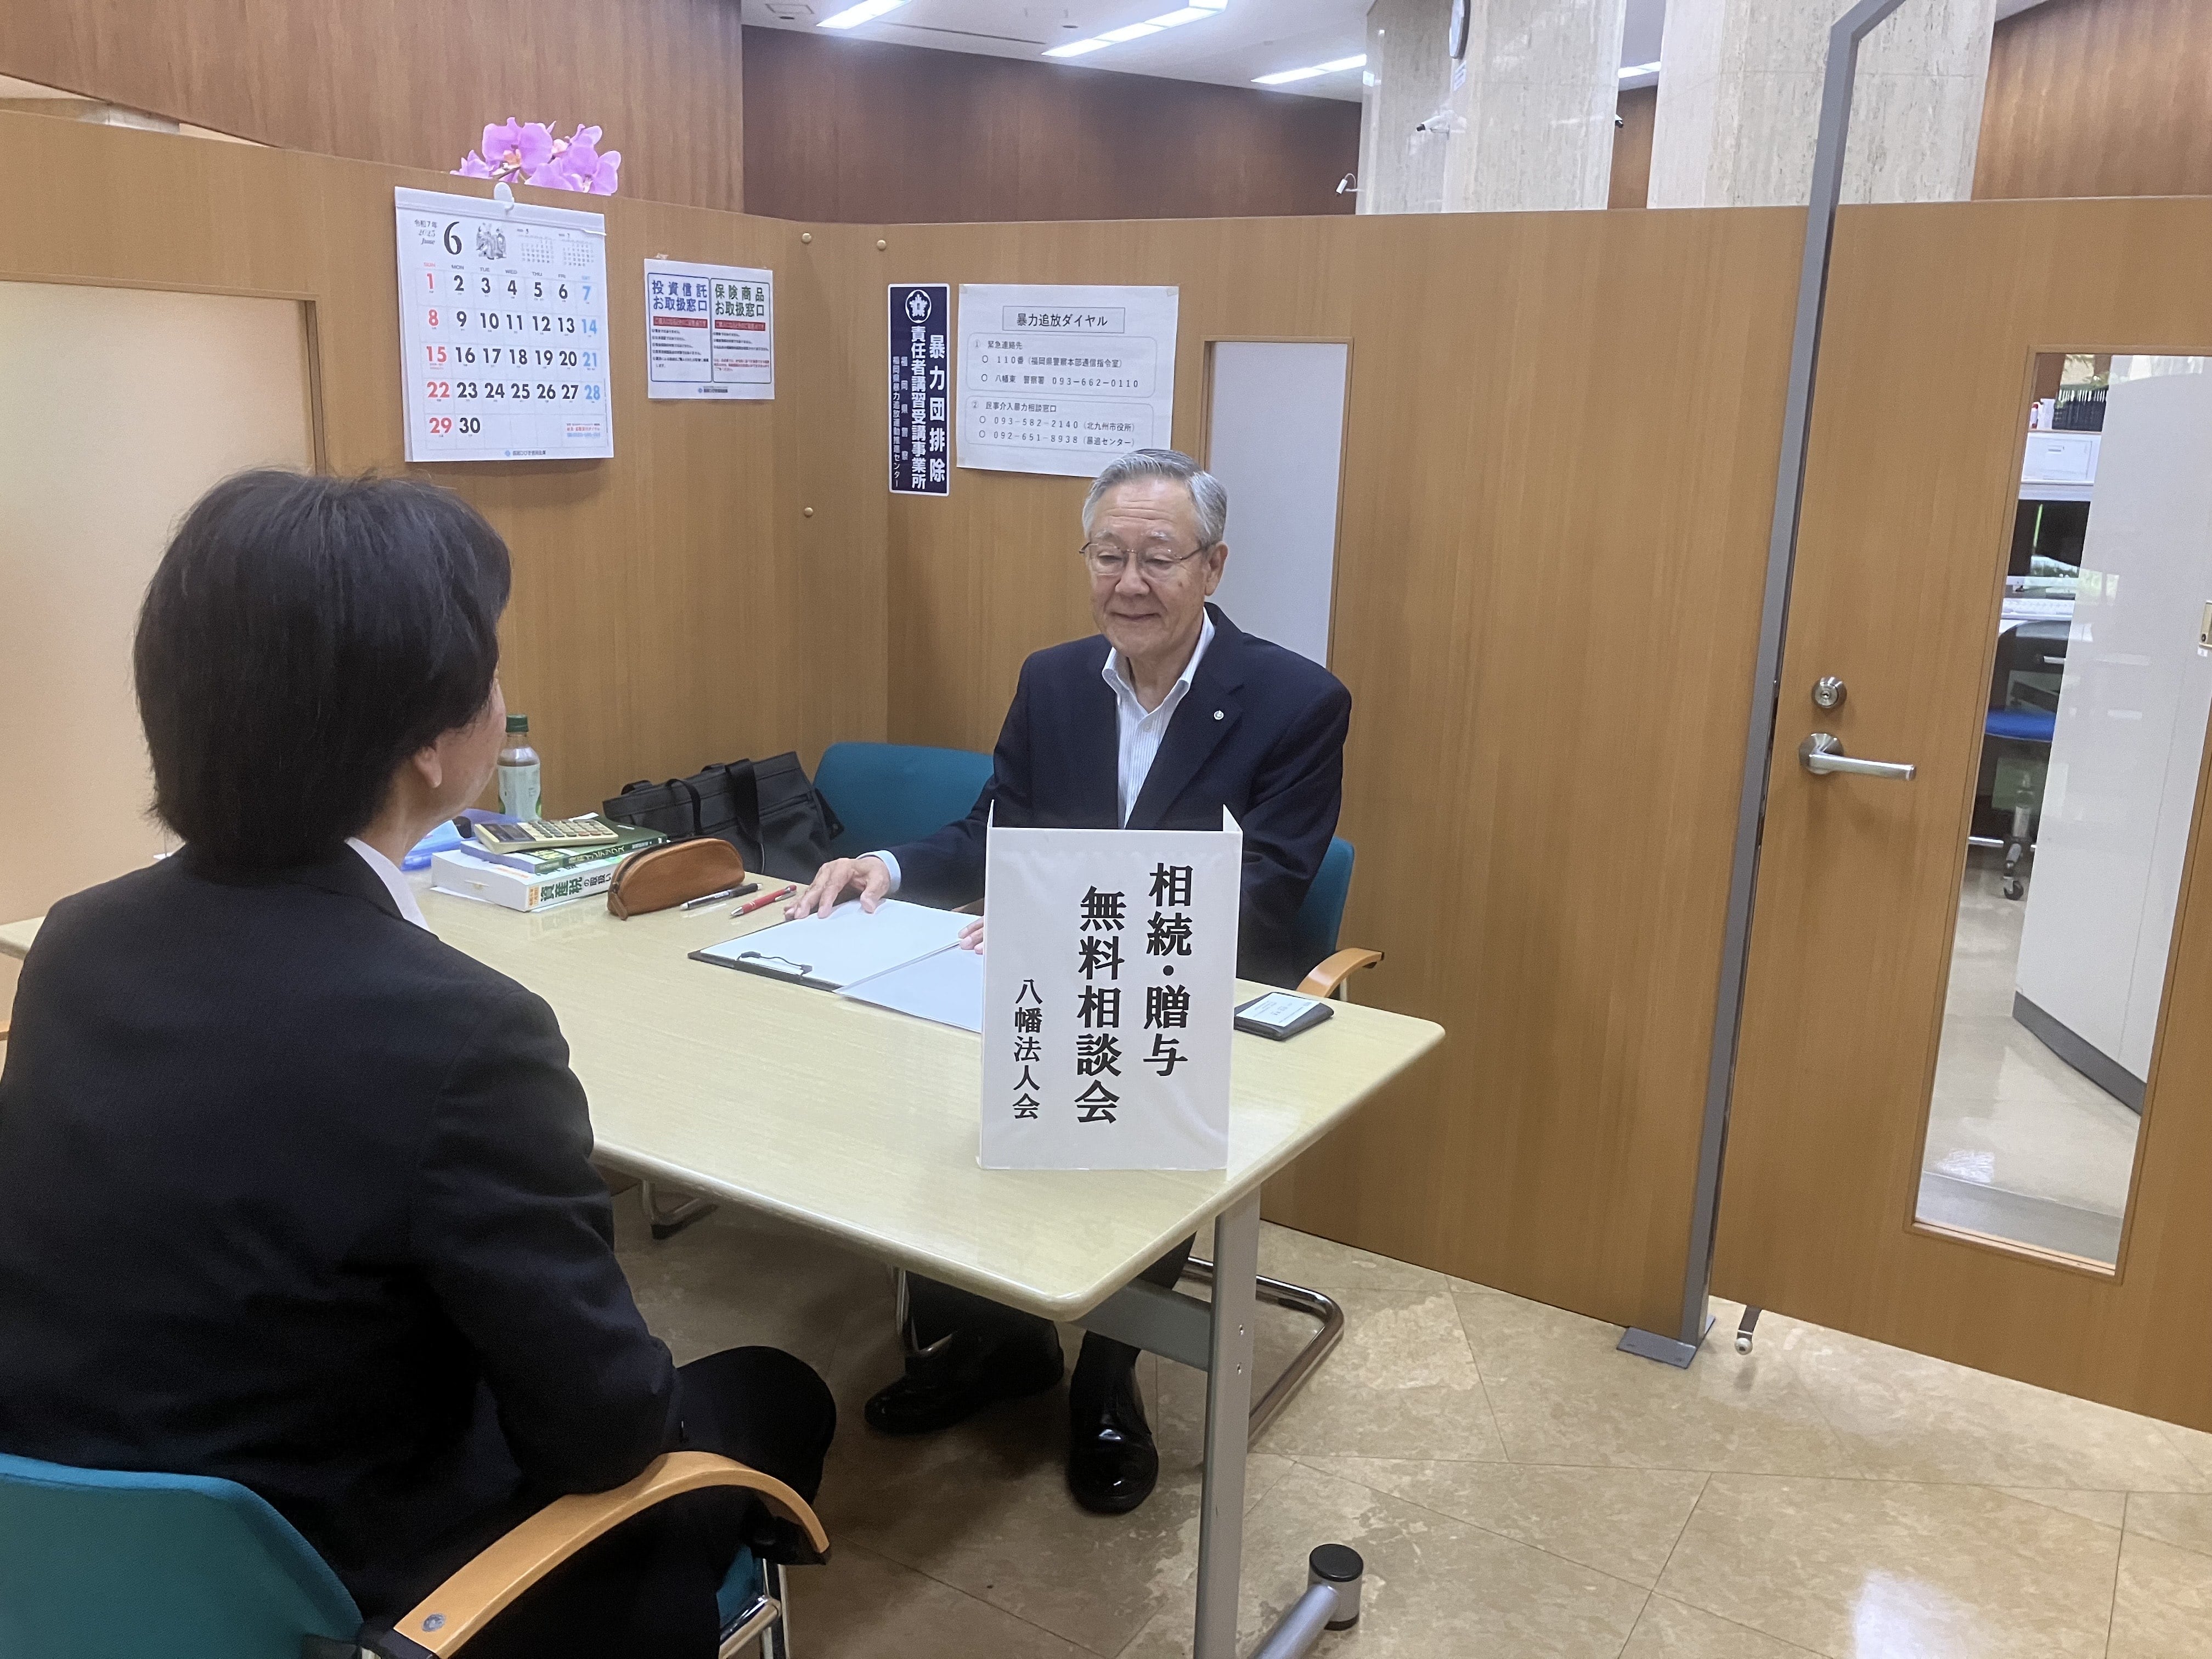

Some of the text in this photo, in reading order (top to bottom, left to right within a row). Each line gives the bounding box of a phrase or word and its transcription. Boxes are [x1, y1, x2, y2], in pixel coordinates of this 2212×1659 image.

[414, 219, 462, 255] 令和7年 6
[426, 273, 591, 301] 1 2 3 4 5 6 7
[652, 280, 707, 298] 投資信託
[715, 284, 764, 302] 保険商品
[653, 296, 707, 312] お取扱窓口
[715, 301, 764, 317] お取扱窓口
[428, 309, 597, 334] 8 9 10 11 12 13 14
[1017, 313, 1108, 327] 暴力追放ダイヤル
[988, 341, 1023, 349] 緊急連絡先
[426, 346, 597, 367] 15 16 17 18 19 20 21
[995, 375, 1015, 383] 八幡東
[1052, 377, 1138, 387] 093-662-0110
[427, 382, 600, 400] 22 23 24 25 26 27 28
[911, 326, 926, 489] 責任者講習受講事業所
[929, 335, 945, 483] 暴力団排除
[985, 401, 1057, 413] 民事介入暴力相談窓口
[429, 417, 480, 433] 29 30
[540, 873, 611, 901] 資産税の取扱い
[1143, 862, 1193, 1076] 相続・贈与
[1074, 885, 1127, 1124] 無料相談会
[1012, 979, 1042, 1120] 八幡法人会
